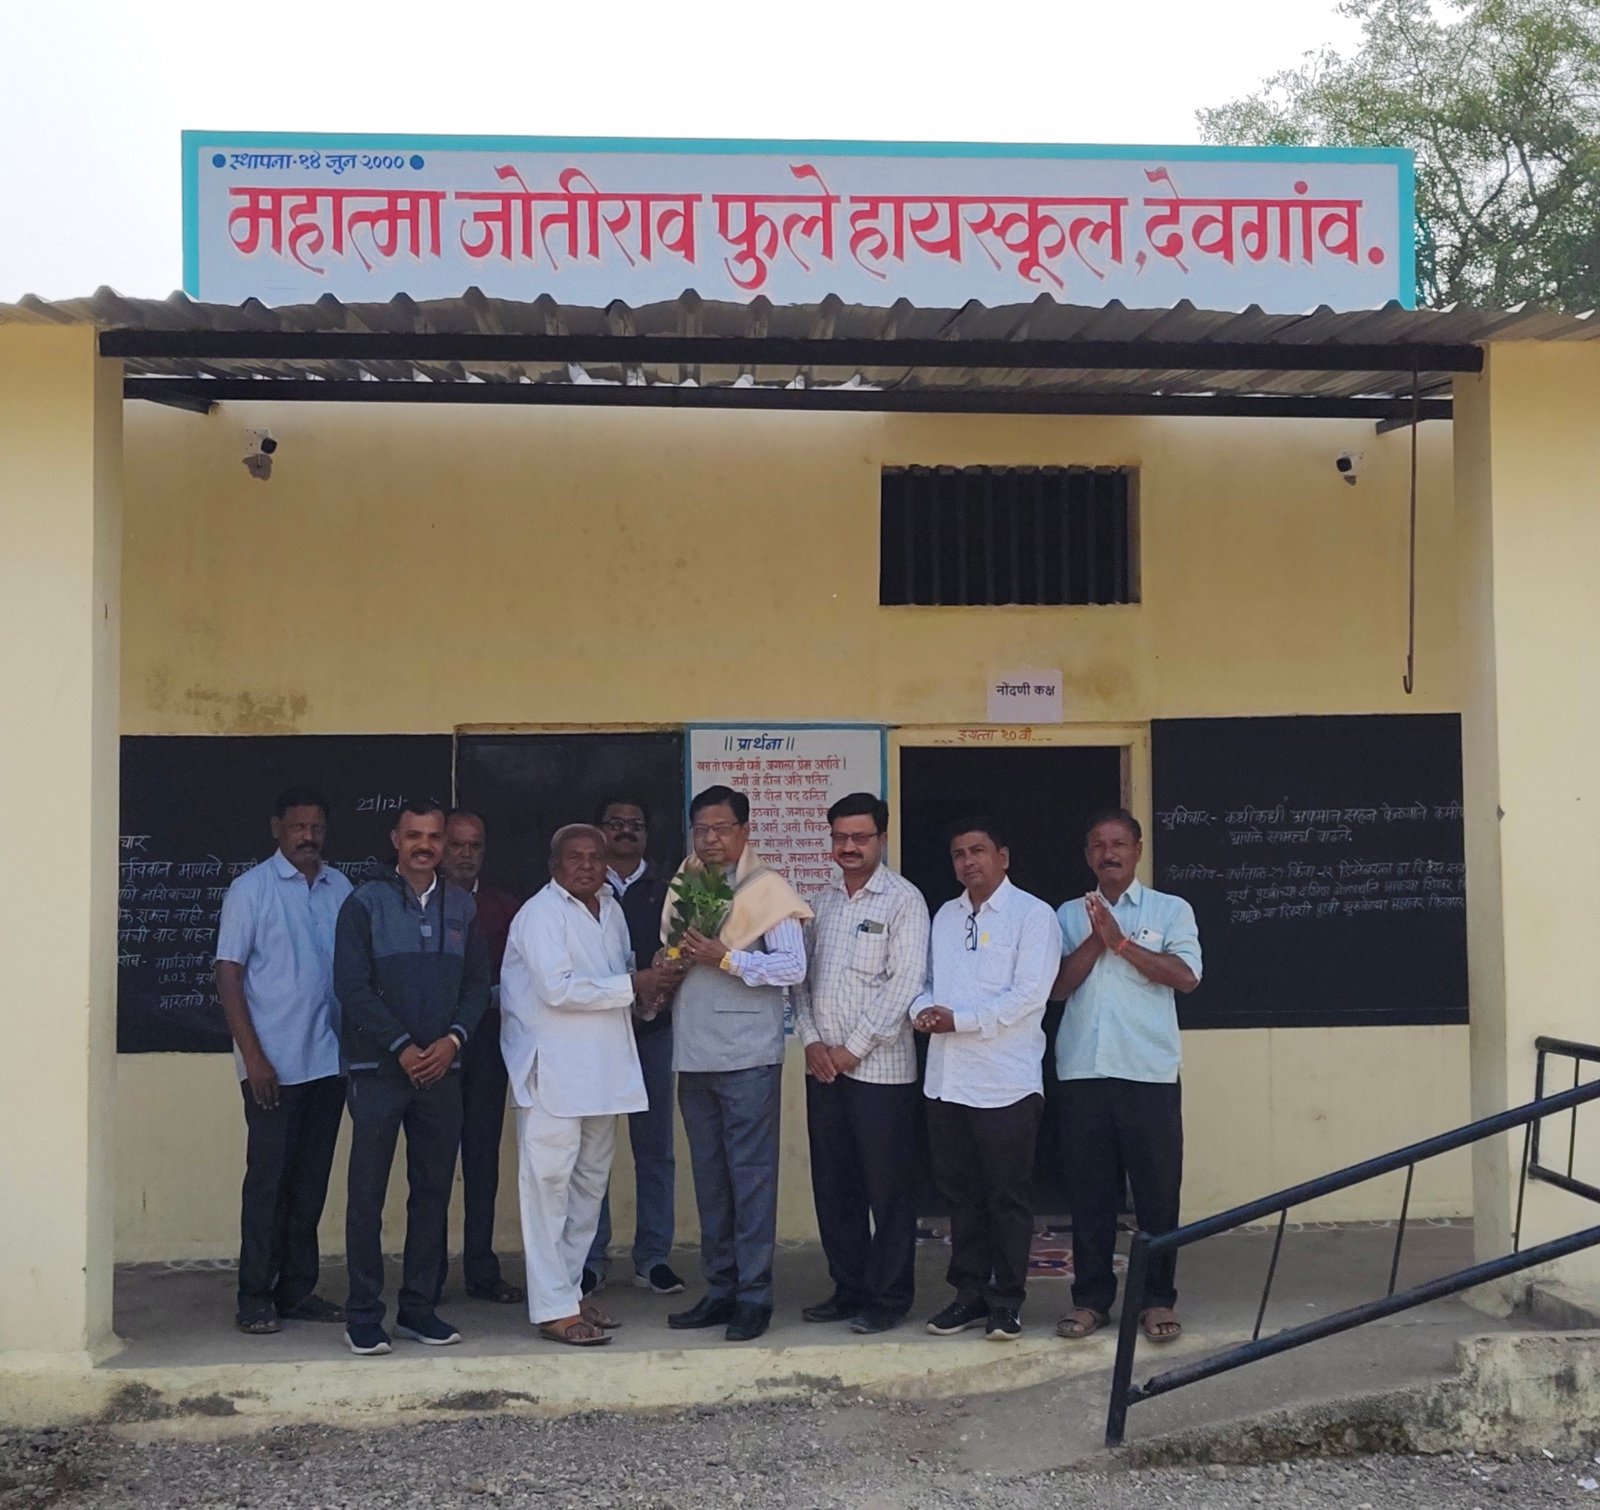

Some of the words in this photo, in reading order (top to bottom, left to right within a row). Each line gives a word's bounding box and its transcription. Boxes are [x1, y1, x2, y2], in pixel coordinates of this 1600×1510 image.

[360, 155, 404, 171] २०००
[228, 186, 447, 275] महात्मा
[455, 164, 703, 270] जोतीराव
[712, 164, 842, 291] फुले
[996, 682, 1031, 697] नोंदणी
[1034, 685, 1055, 697] कक्ष
[737, 733, 785, 752] प्रार्थना
